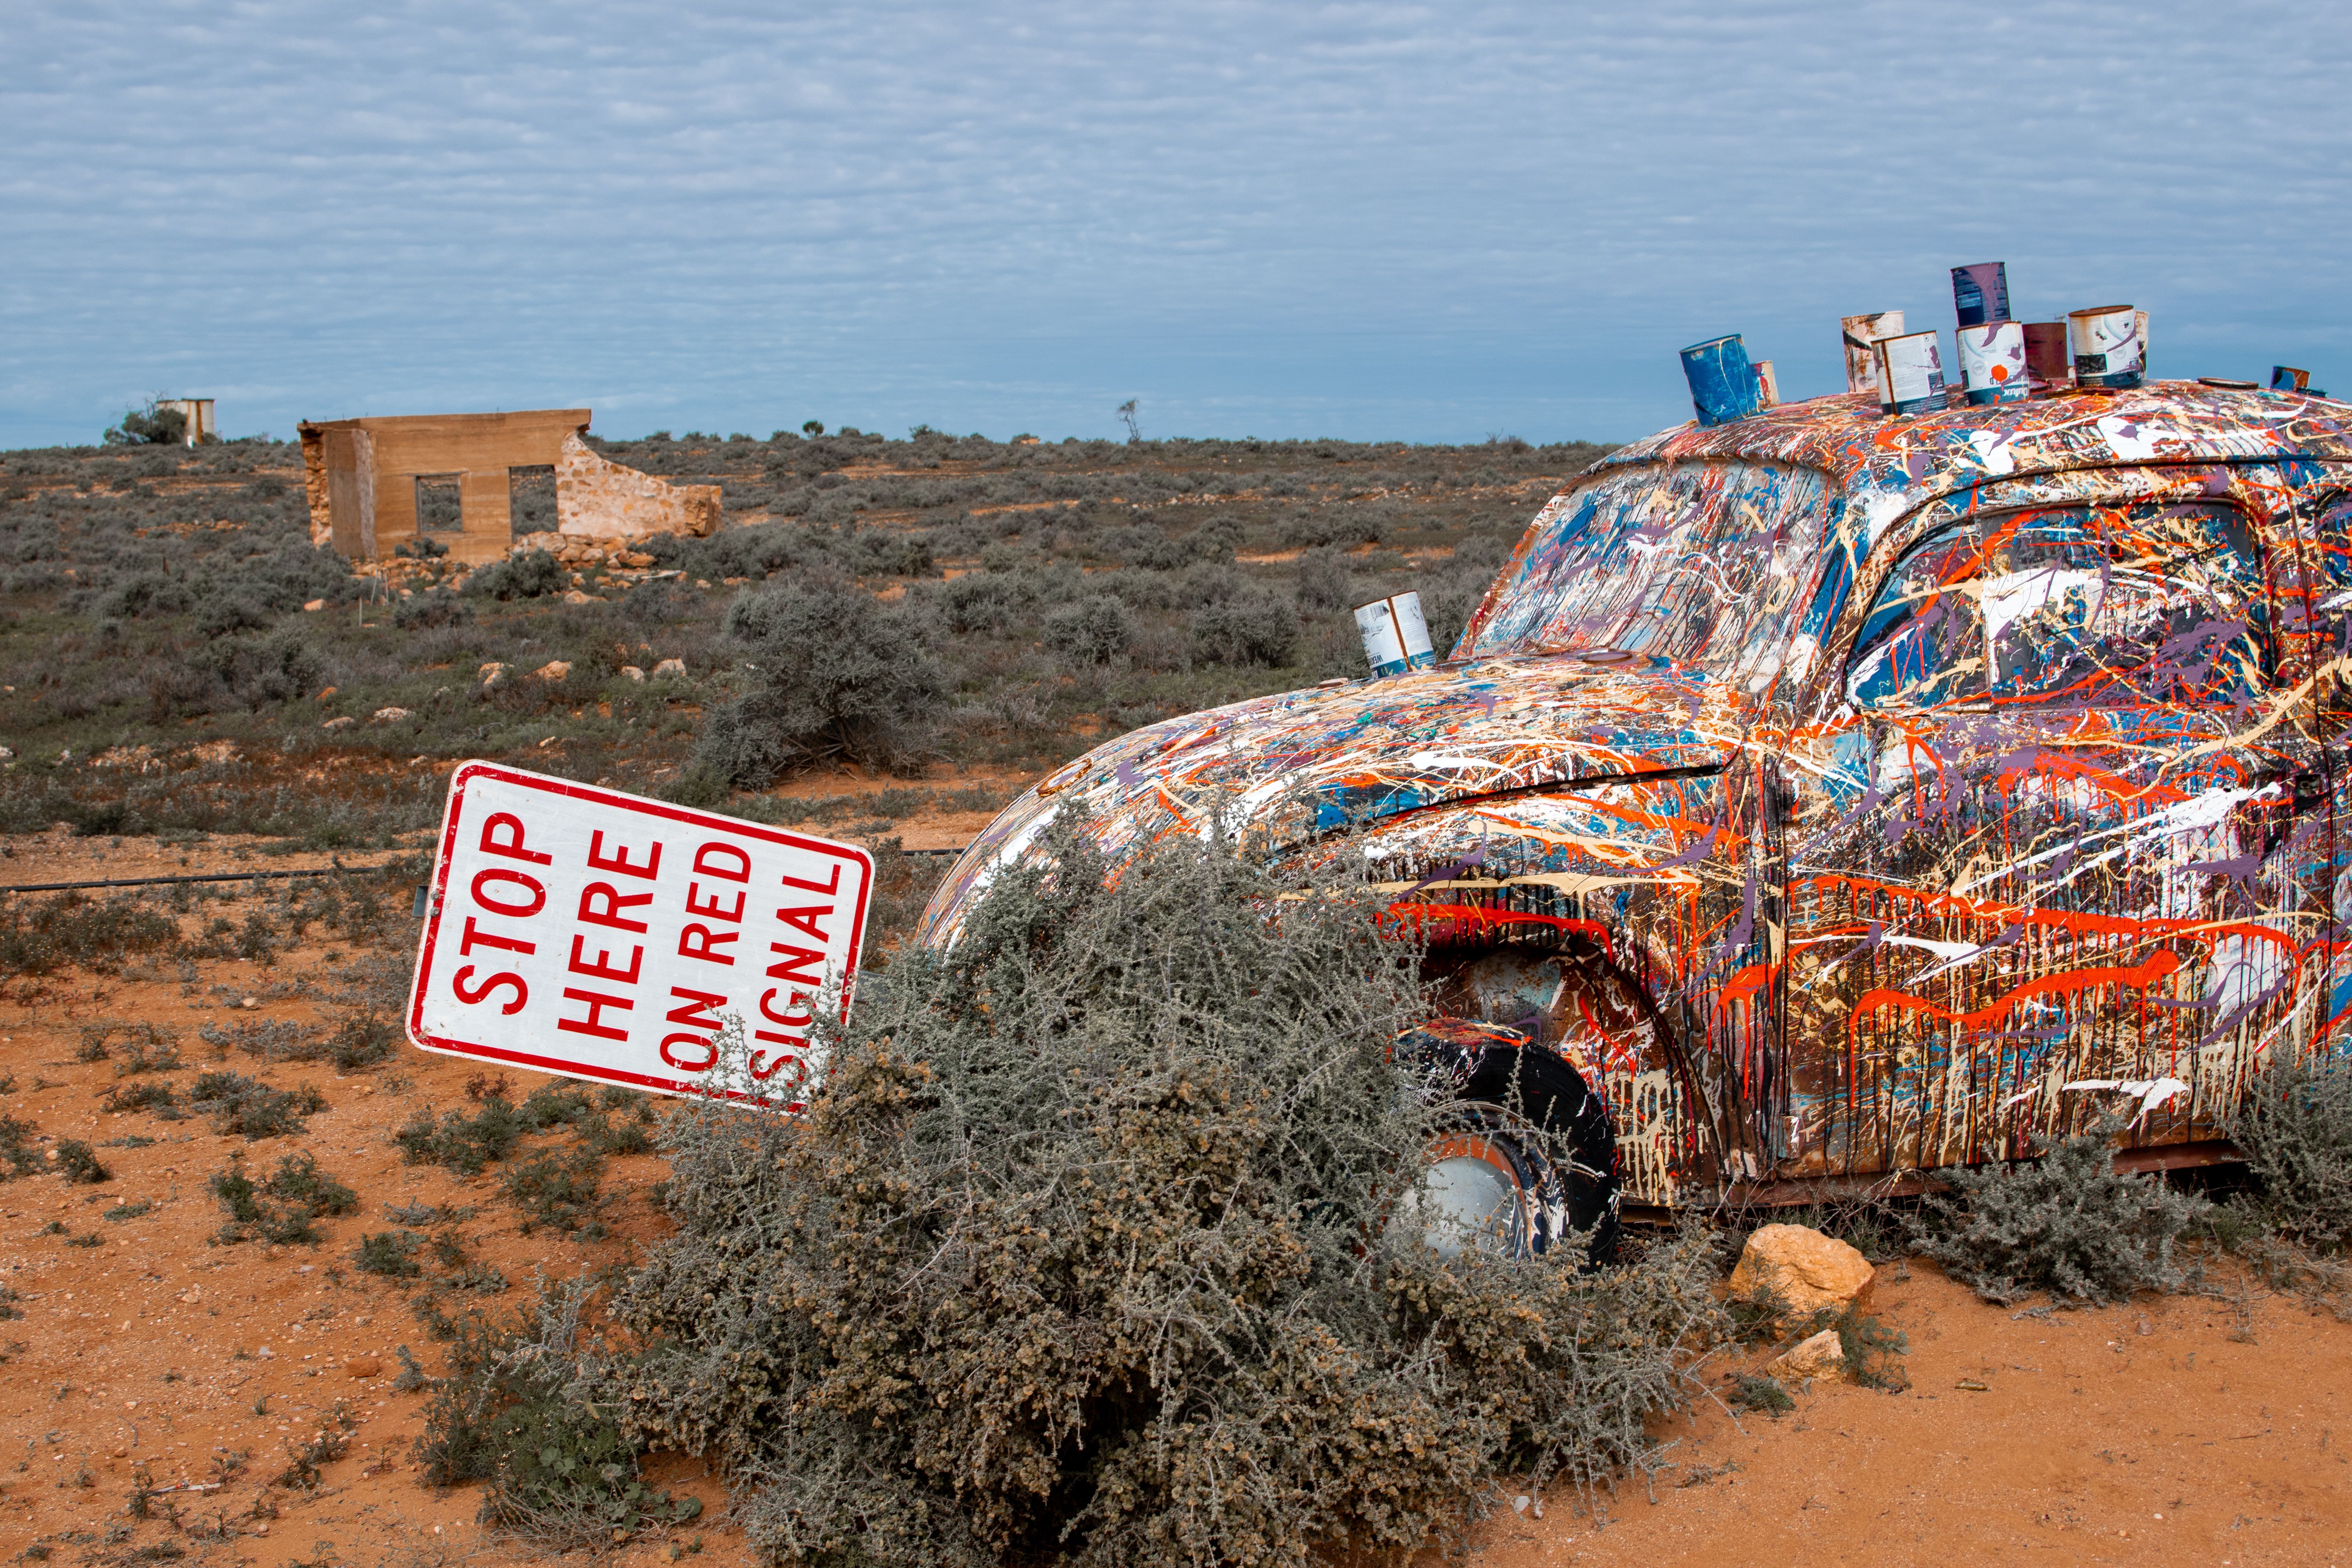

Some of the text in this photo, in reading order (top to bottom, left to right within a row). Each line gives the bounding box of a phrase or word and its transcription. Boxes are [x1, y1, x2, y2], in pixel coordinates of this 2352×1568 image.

[2004, 388, 2027, 397] Dulux
[453, 812, 552, 1015] STOP
[557, 829, 663, 1042] HERE
[659, 842, 751, 1072] ON RED
[749, 864, 841, 1088] SIGNAL
